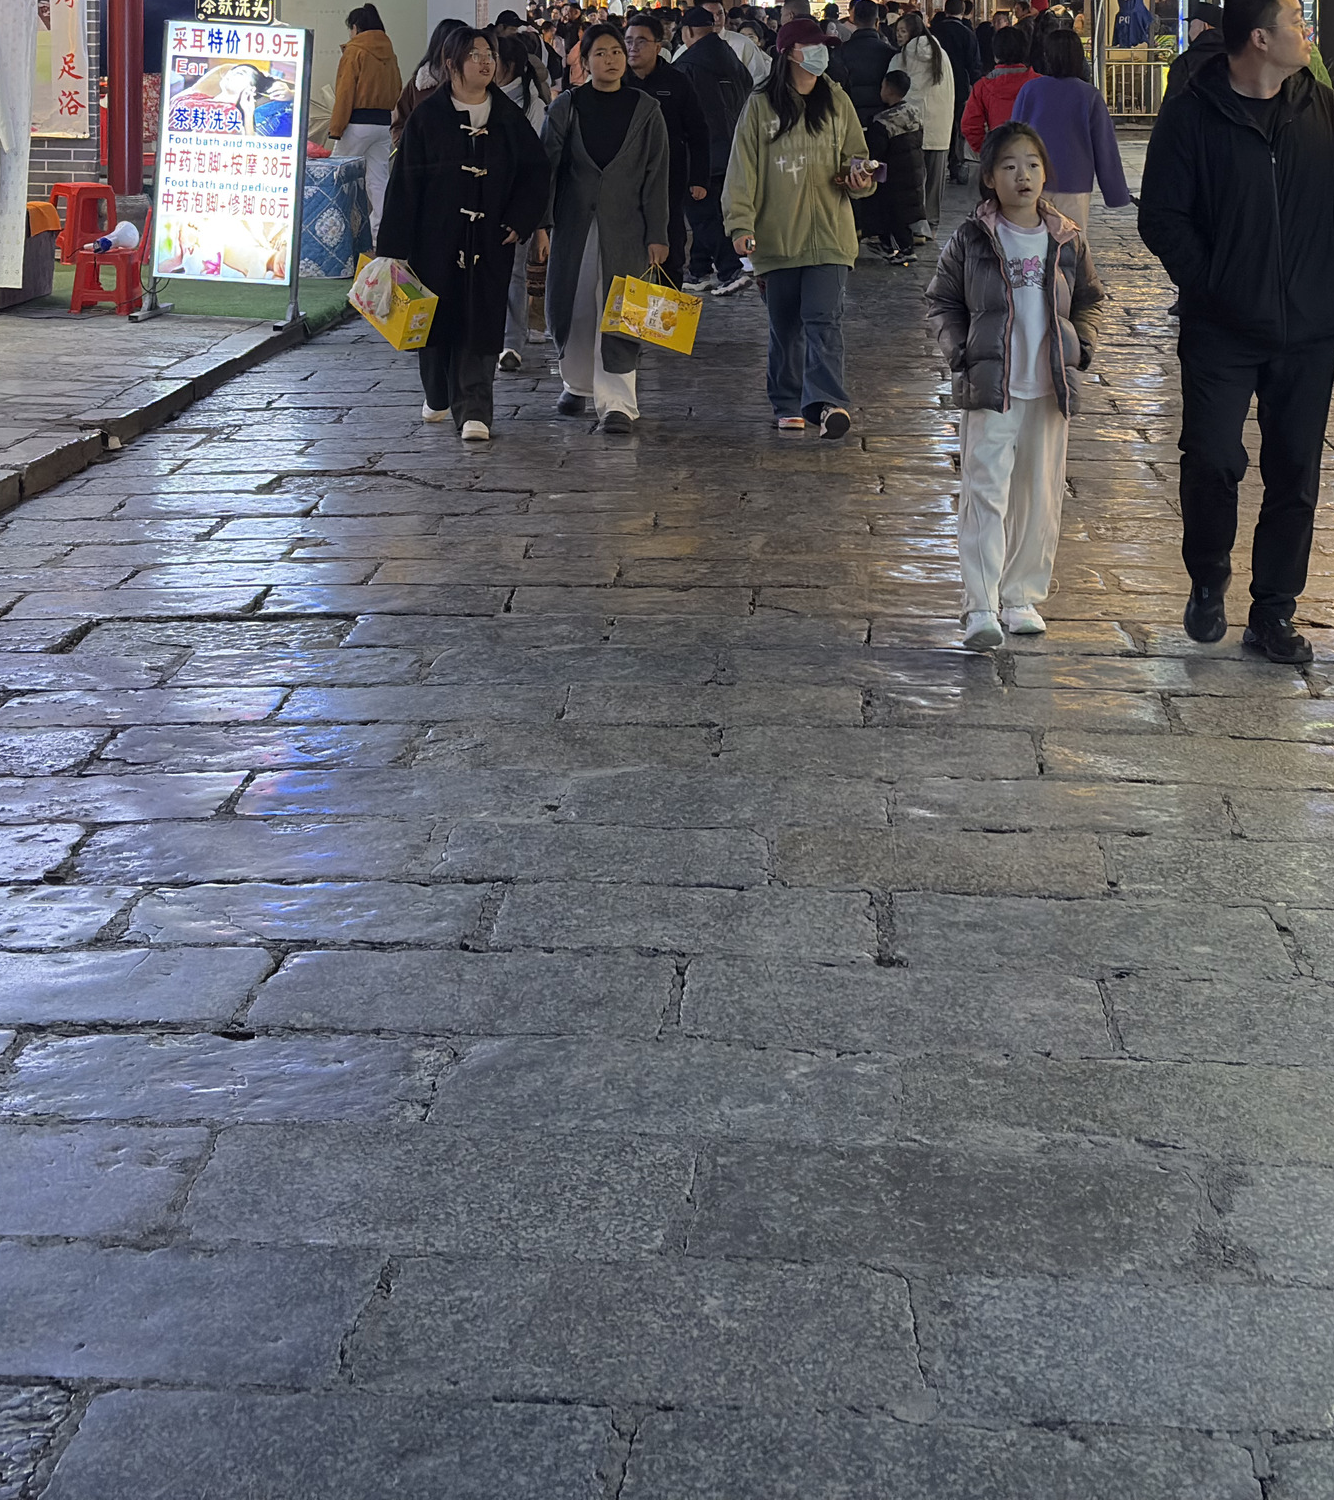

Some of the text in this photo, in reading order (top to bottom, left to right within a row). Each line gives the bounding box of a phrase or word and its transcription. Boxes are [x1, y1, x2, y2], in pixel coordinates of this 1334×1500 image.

[175, 58, 209, 76] Ear
[57, 53, 87, 117] 足浴
[168, 134, 293, 152] Foot bath and massage
[164, 177, 289, 195] Foot bath and pedicure
